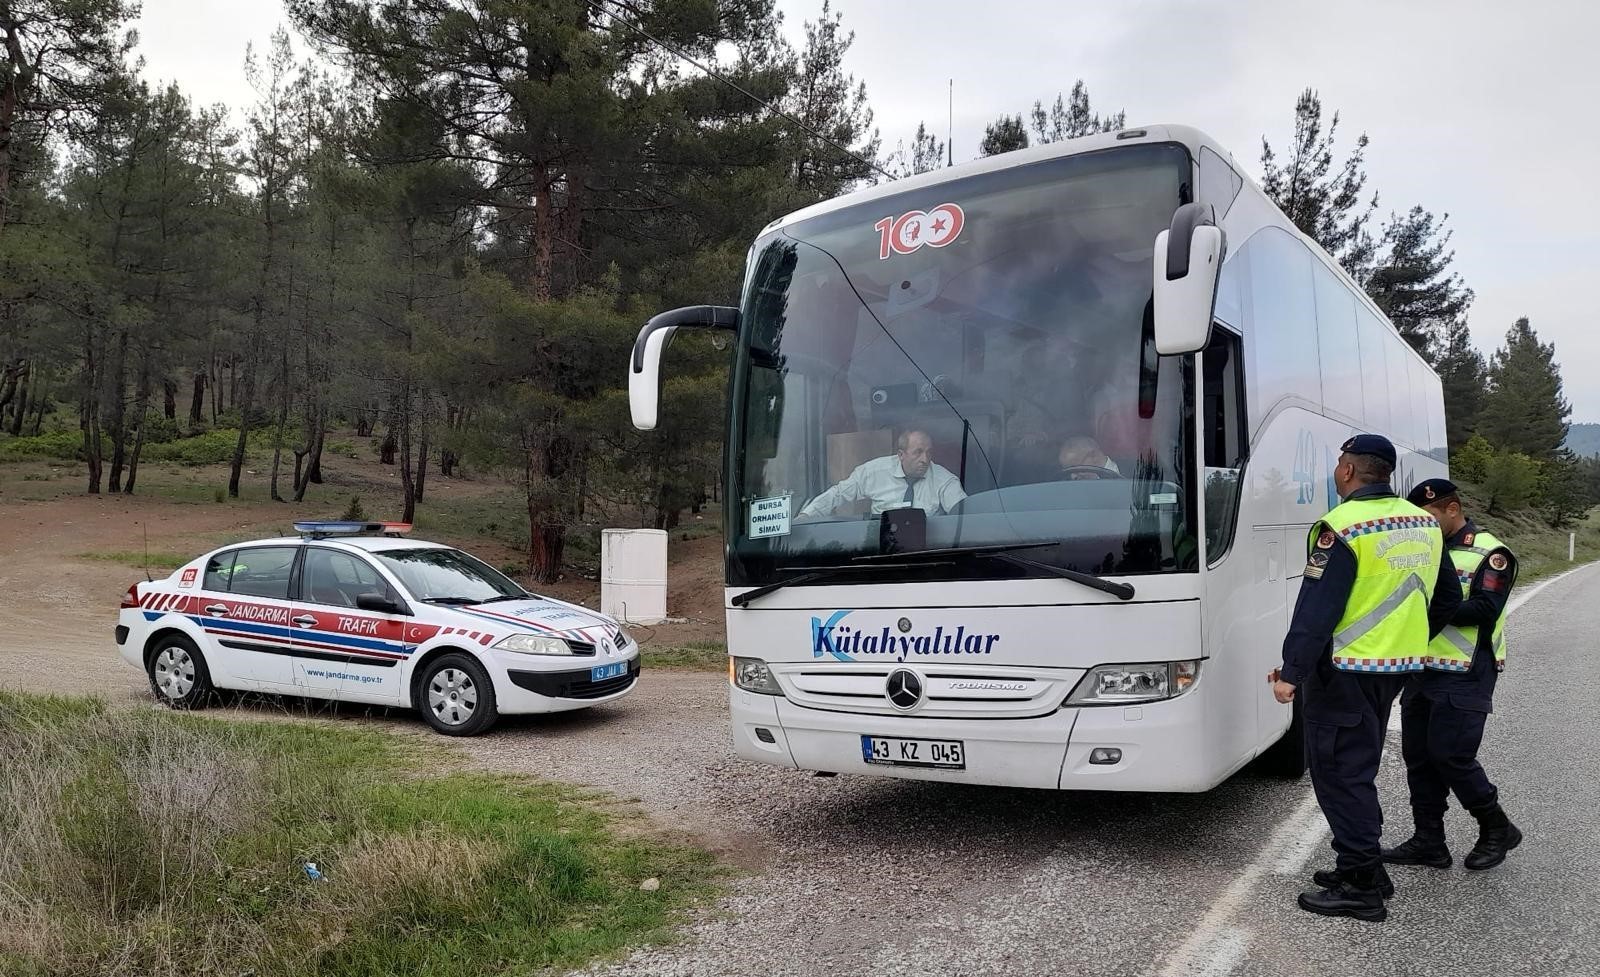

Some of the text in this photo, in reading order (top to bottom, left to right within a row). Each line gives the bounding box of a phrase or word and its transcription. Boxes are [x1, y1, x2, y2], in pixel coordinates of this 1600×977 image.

[758, 501, 782, 511] BURSA
[752, 511, 788, 523] ORHANELİ
[758, 525, 781, 534] SİMAV
[229, 604, 288, 623] JANDARMA
[814, 625, 1000, 663] Kütahyalılar
[307, 669, 383, 684] www.jandarma.gov.tr
[949, 682, 1028, 690] TOURISMO
[873, 740, 960, 762] 43 KZ 045
